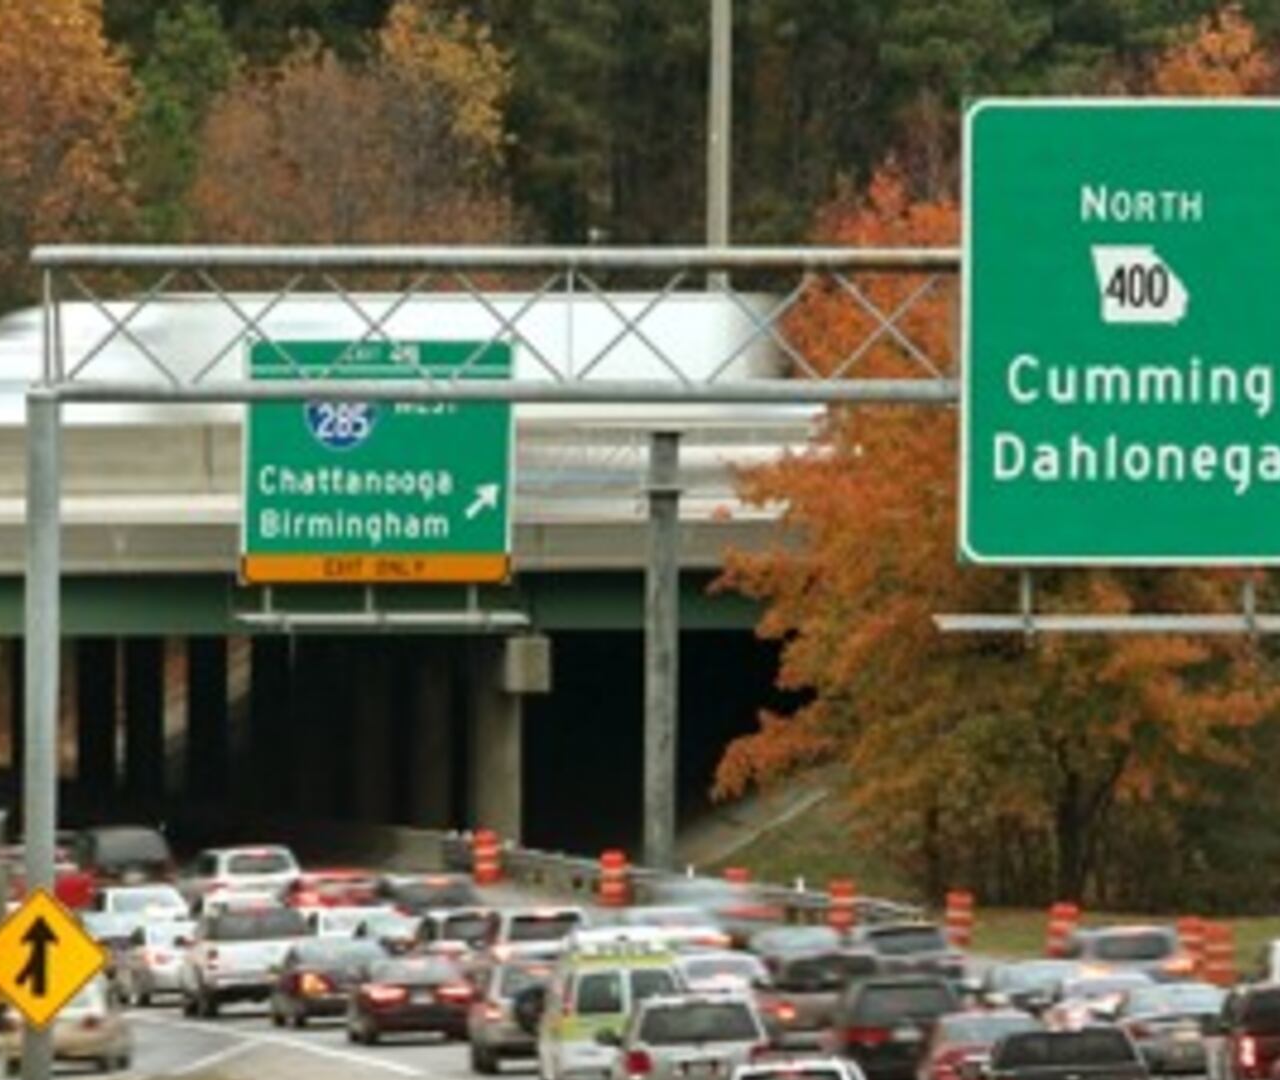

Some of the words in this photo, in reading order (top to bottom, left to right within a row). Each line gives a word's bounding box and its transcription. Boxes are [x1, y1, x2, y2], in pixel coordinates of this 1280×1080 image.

[1080, 184, 1204, 223] NORTH
[1105, 262, 1170, 309] 400
[1007, 354, 1274, 419] Cumming
[316, 399, 371, 439] 285
[257, 464, 455, 501] Chattanooga
[258, 507, 451, 547] Birmingham
